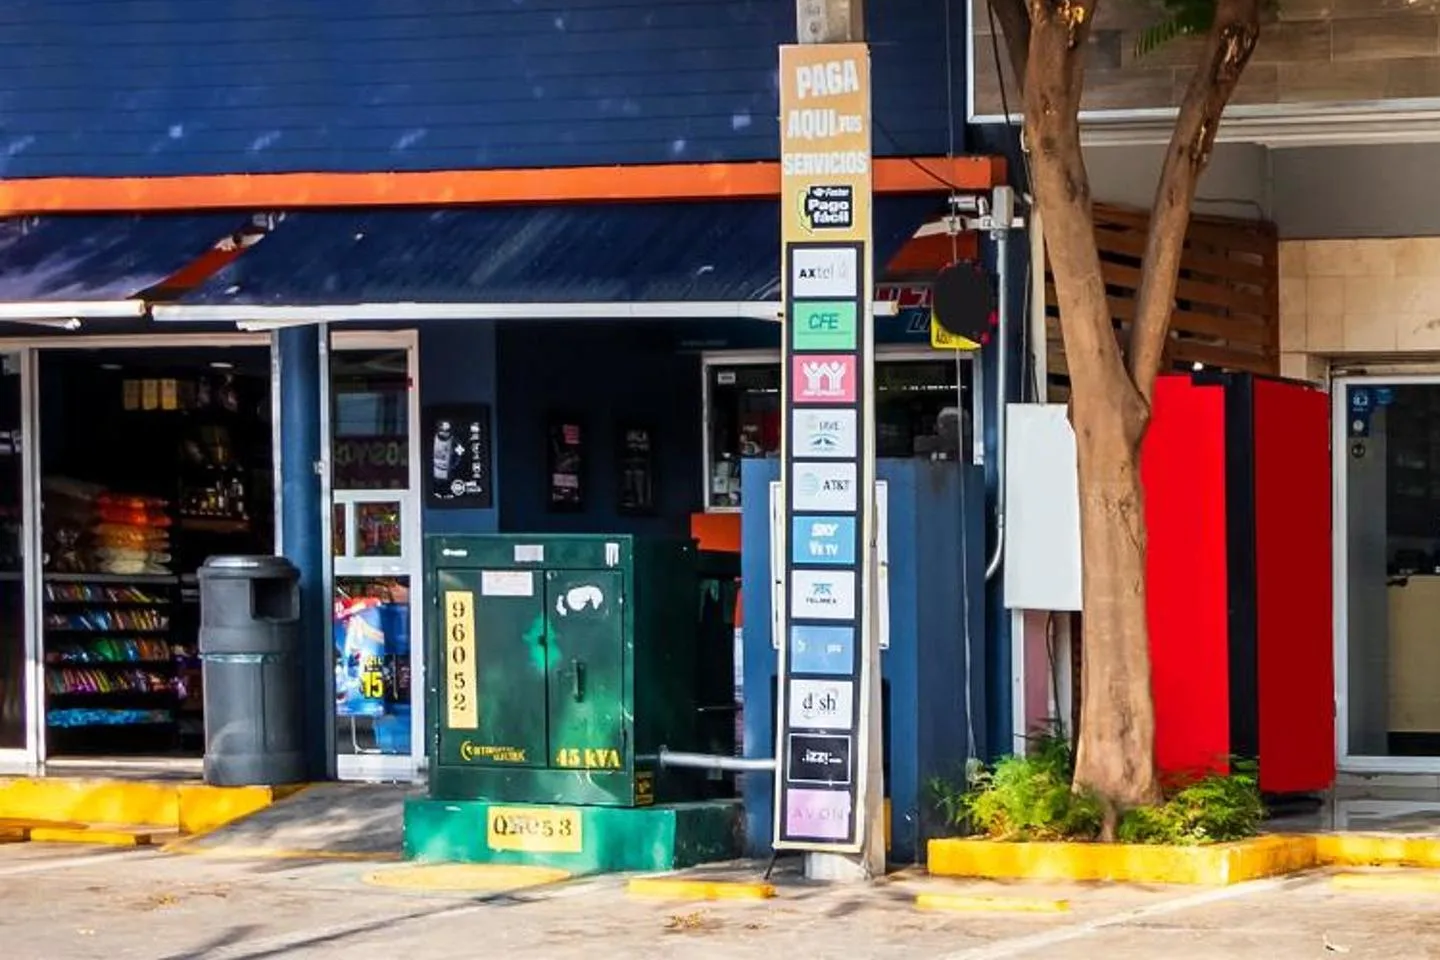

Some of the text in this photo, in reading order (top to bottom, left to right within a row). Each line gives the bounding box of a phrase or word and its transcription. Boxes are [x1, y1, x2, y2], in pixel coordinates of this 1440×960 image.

[796, 59, 860, 100] PAGA
[784, 150, 868, 176] SERVICIOS
[808, 198, 849, 214] Pago
[808, 312, 839, 330] CFE
[823, 480, 850, 491] AT&T
[451, 599, 467, 712] 96052
[802, 692, 836, 711] dsh
[556, 749, 579, 767] 45
[793, 806, 845, 822] AVON
